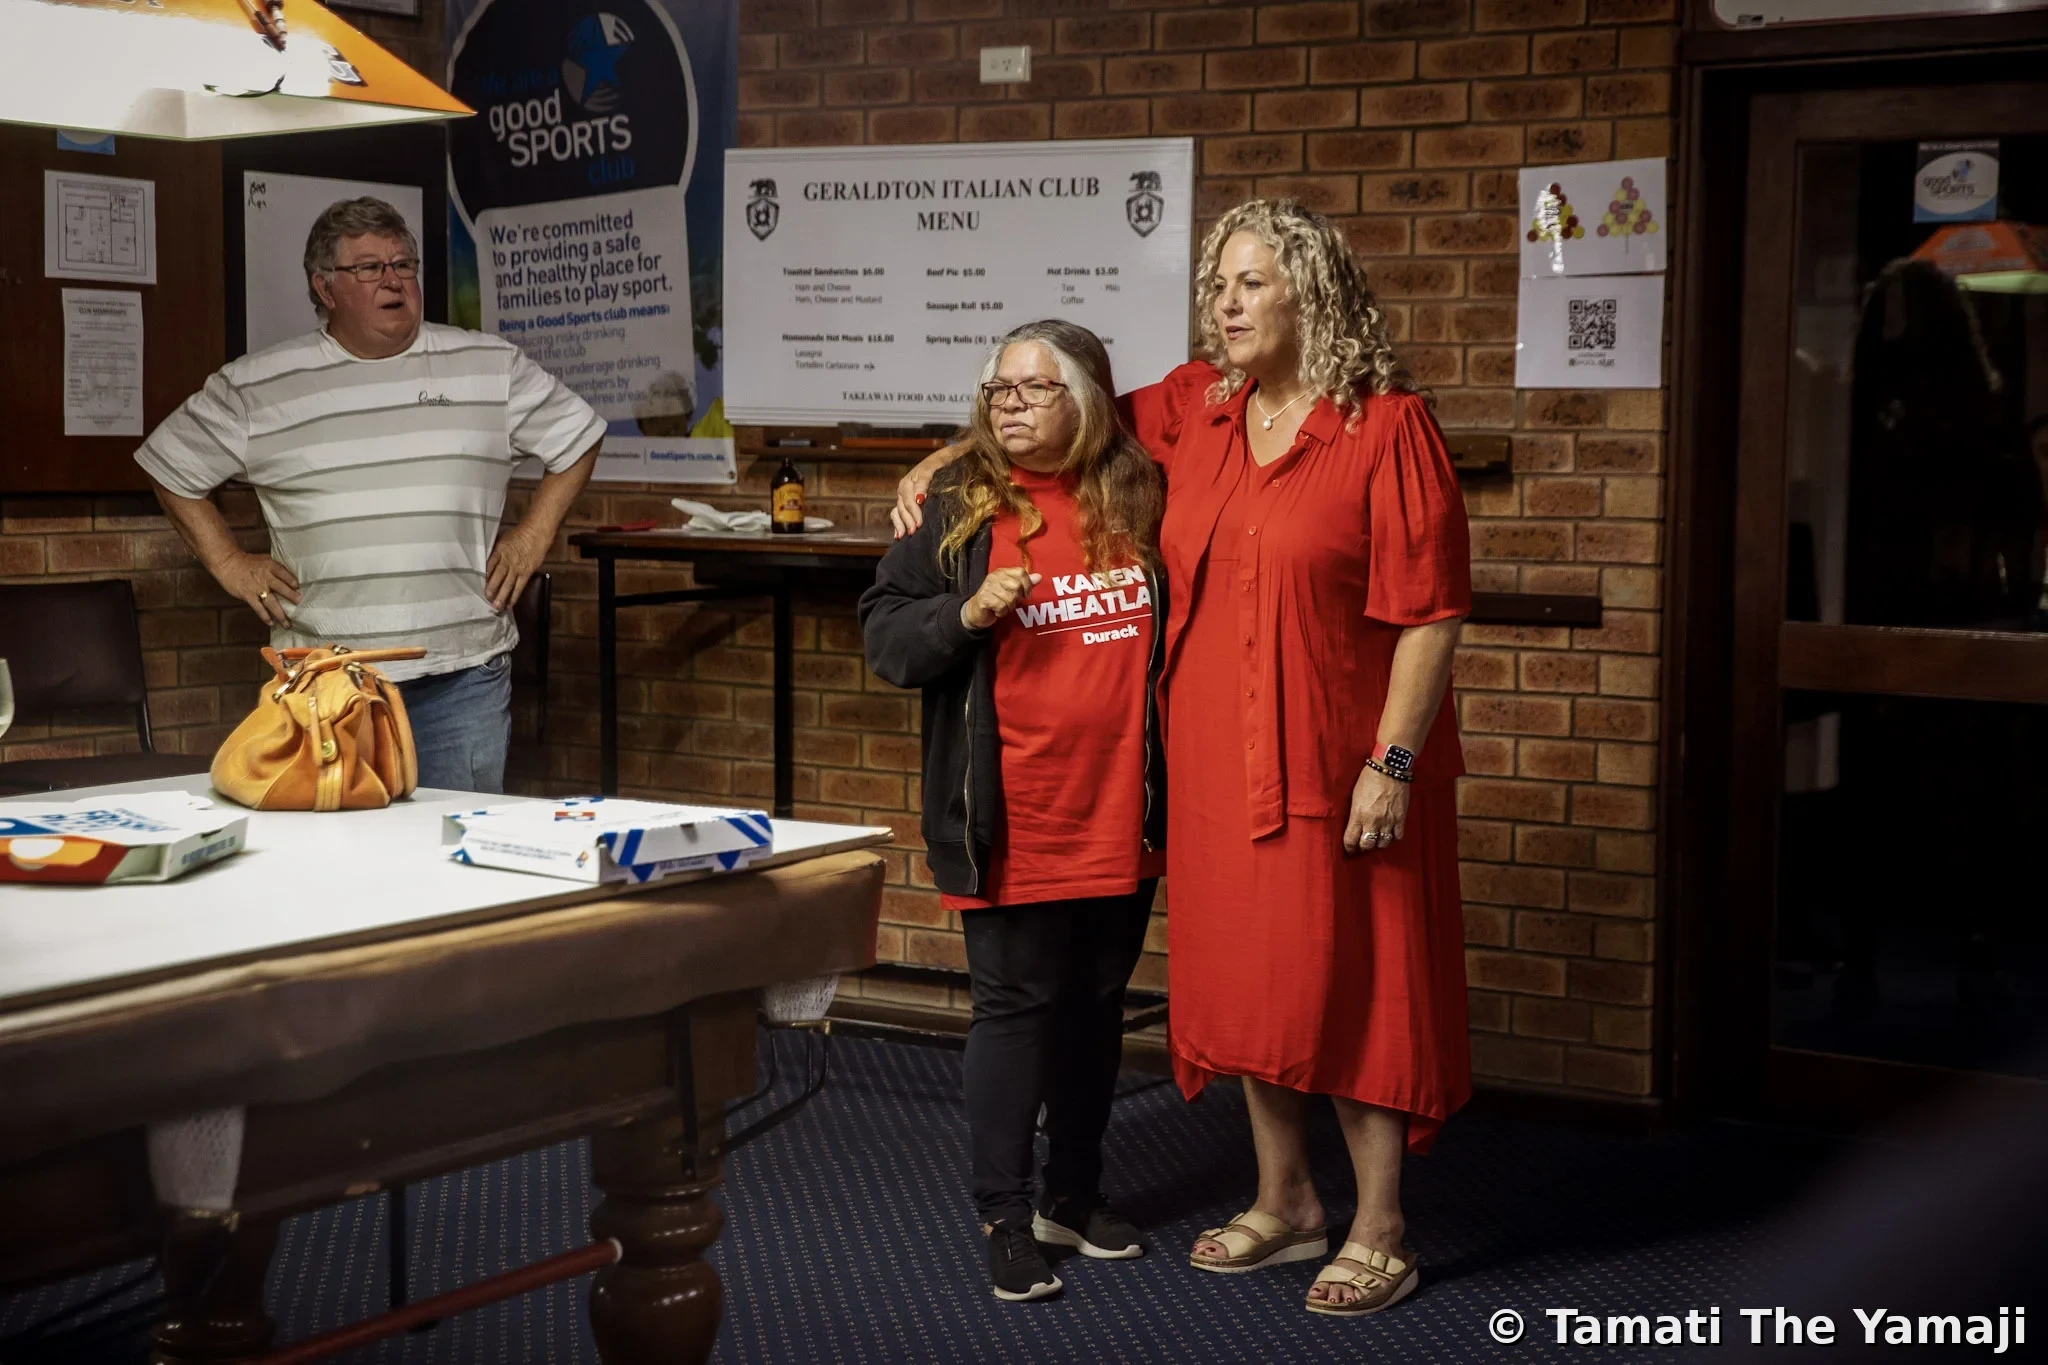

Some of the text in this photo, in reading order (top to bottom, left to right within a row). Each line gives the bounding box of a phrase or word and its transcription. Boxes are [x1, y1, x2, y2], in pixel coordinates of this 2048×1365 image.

[489, 88, 562, 142] good
[508, 114, 632, 168] SPORTS
[588, 157, 635, 185] club
[804, 176, 1100, 202] GERALDTON ITALIAN CLUB
[490, 208, 633, 245] We're committed
[917, 211, 980, 231] MENU
[493, 232, 641, 269] to providing a safe
[495, 252, 662, 289] and healthy place for
[783, 267, 812, 276] Toasted
[814, 267, 858, 276] Sandwiches
[926, 268, 944, 277] Beef
[946, 268, 958, 277] Pie
[1047, 266, 1119, 276] Hot Drinks $3.00
[497, 273, 673, 310] families to play sport.
[795, 283, 851, 292] Ham and Cheese
[815, 295, 838, 304] Cheese
[841, 296, 854, 304] and
[926, 301, 959, 311] Sausage
[961, 301, 976, 310] Roll
[1061, 296, 1085, 305] Coffee
[499, 318, 527, 332] Being
[528, 318, 535, 329] a
[536, 313, 566, 328] Good
[567, 309, 601, 326] Sports
[604, 306, 627, 321] club
[556, 327, 581, 345] risky
[582, 324, 626, 342] drinking
[782, 333, 824, 342] Homemade
[826, 333, 840, 342] Hot
[926, 335, 952, 345] Spring
[953, 335, 972, 344] Rolls
[544, 344, 562, 361] the
[564, 342, 587, 358] club
[564, 359, 615, 379] underage
[617, 354, 661, 373] drinking
[617, 374, 631, 391] by
[842, 391, 896, 402] TAKEAWAY
[897, 392, 924, 402] FOOD
[926, 392, 946, 402] AND
[1052, 565, 1146, 597] KAREN
[1016, 586, 1153, 629] WHEATLA
[1082, 623, 1139, 645] Durack
